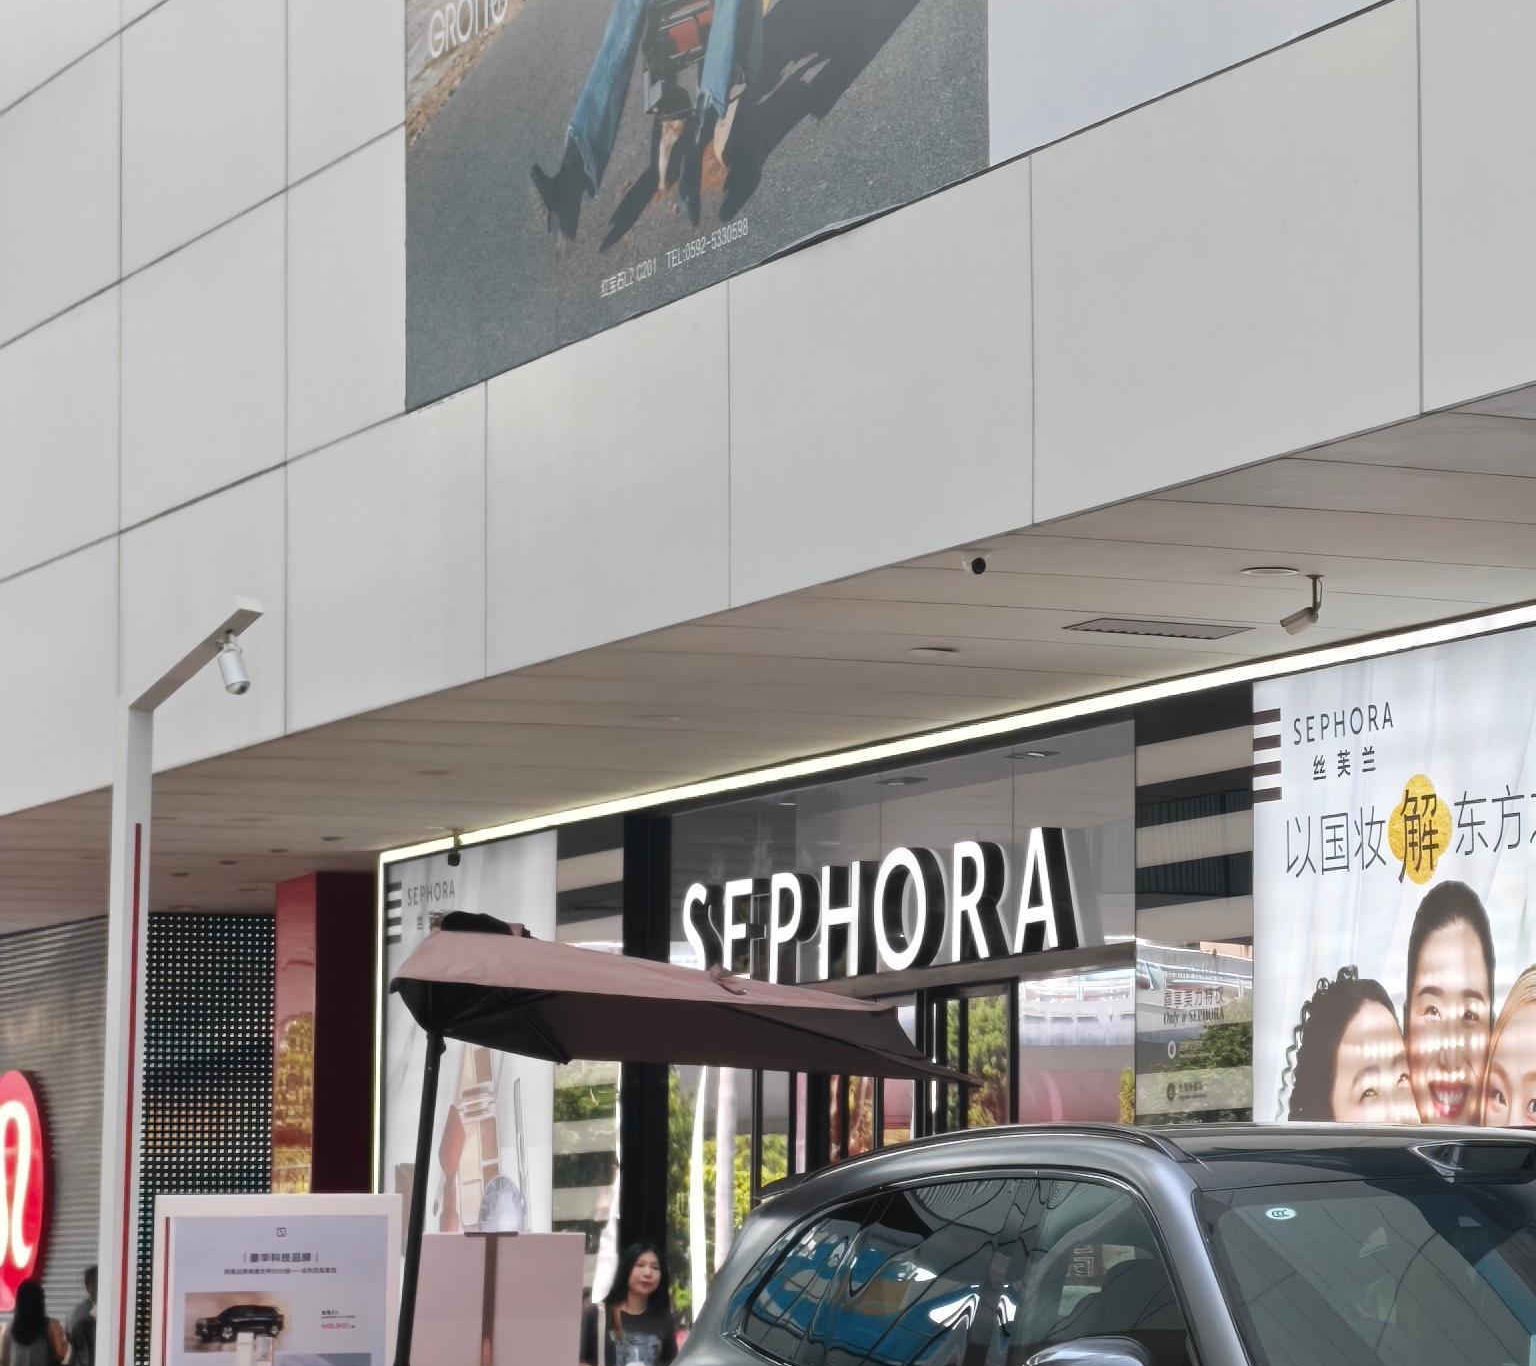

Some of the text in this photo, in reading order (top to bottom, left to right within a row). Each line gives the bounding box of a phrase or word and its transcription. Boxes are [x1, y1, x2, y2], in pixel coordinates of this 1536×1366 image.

[1293, 701, 1394, 746] SEPHORA
[1313, 746, 1377, 780] 丝芙兰
[407, 880, 456, 906] SEPHORA
[682, 826, 1079, 984] SEPHORA
